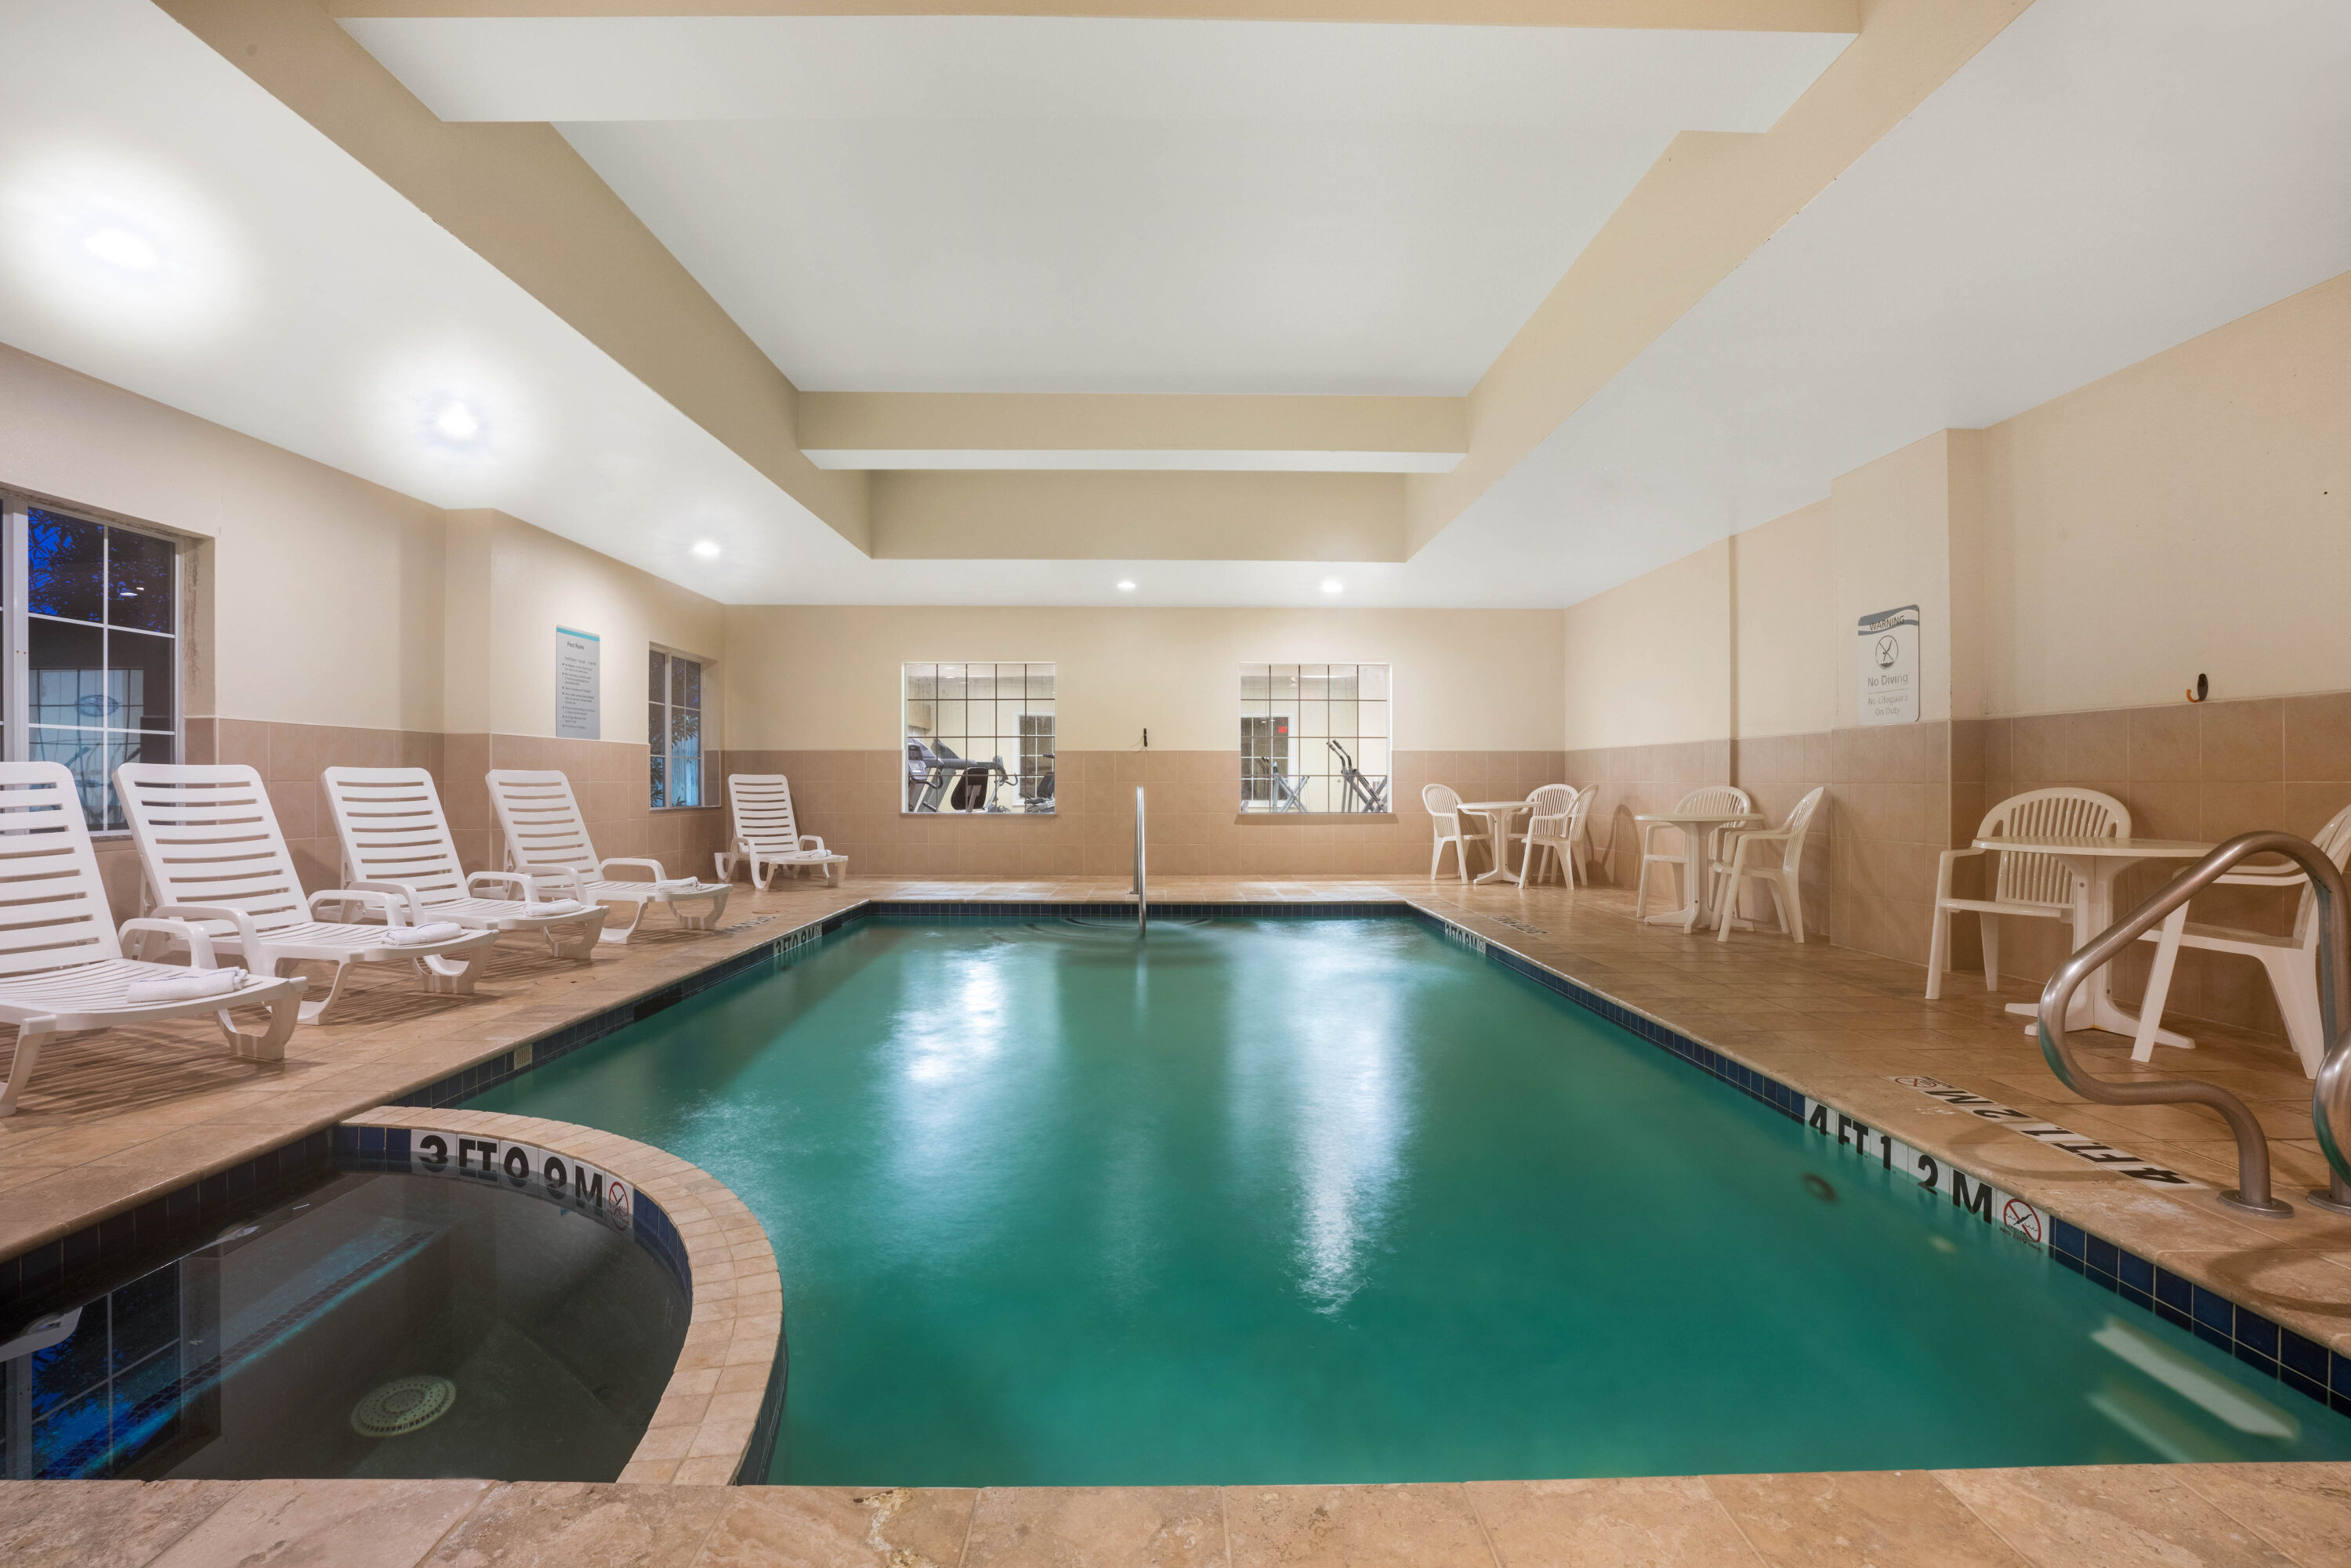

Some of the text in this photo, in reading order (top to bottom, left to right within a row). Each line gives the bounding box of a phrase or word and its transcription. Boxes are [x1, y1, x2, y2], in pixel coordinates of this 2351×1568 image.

[1869, 615, 1905, 631] WARNING
[1867, 674, 1908, 686] No Diving
[1868, 693, 1907, 705] No Lifeguard
[1886, 707, 1900, 716] Duty
[1924, 1090, 1995, 1104] M
[419, 1135, 447, 1164] 3
[575, 1165, 603, 1208] M
[1809, 1104, 1830, 1135] 4
[1953, 1169, 1992, 1224] M
[2119, 1167, 2190, 1184] 4
